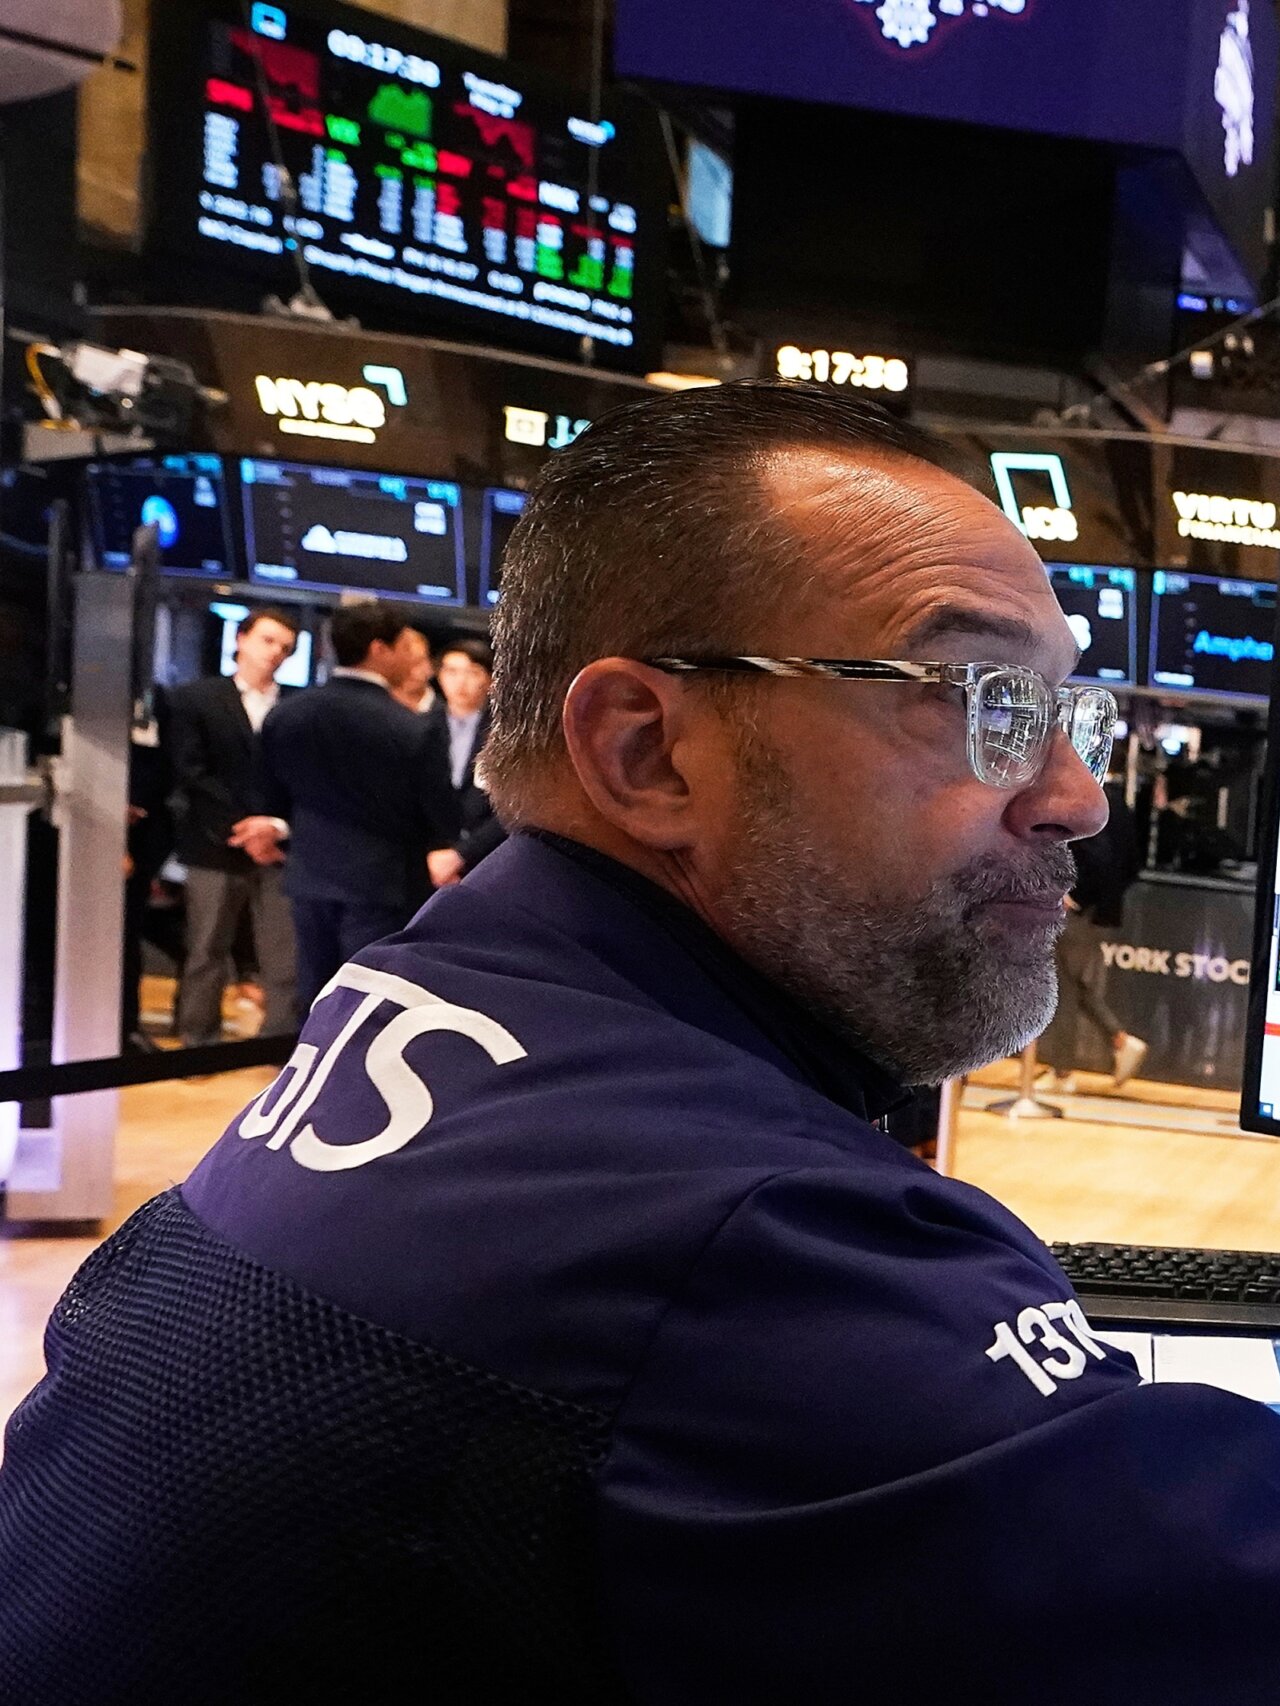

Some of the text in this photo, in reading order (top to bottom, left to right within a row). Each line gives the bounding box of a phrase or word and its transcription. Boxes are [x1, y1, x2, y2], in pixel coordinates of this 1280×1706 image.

[255, 375, 385, 428] NYSE
[1173, 491, 1276, 529] VIRTU
[1100, 941, 1250, 985] YORK STOC
